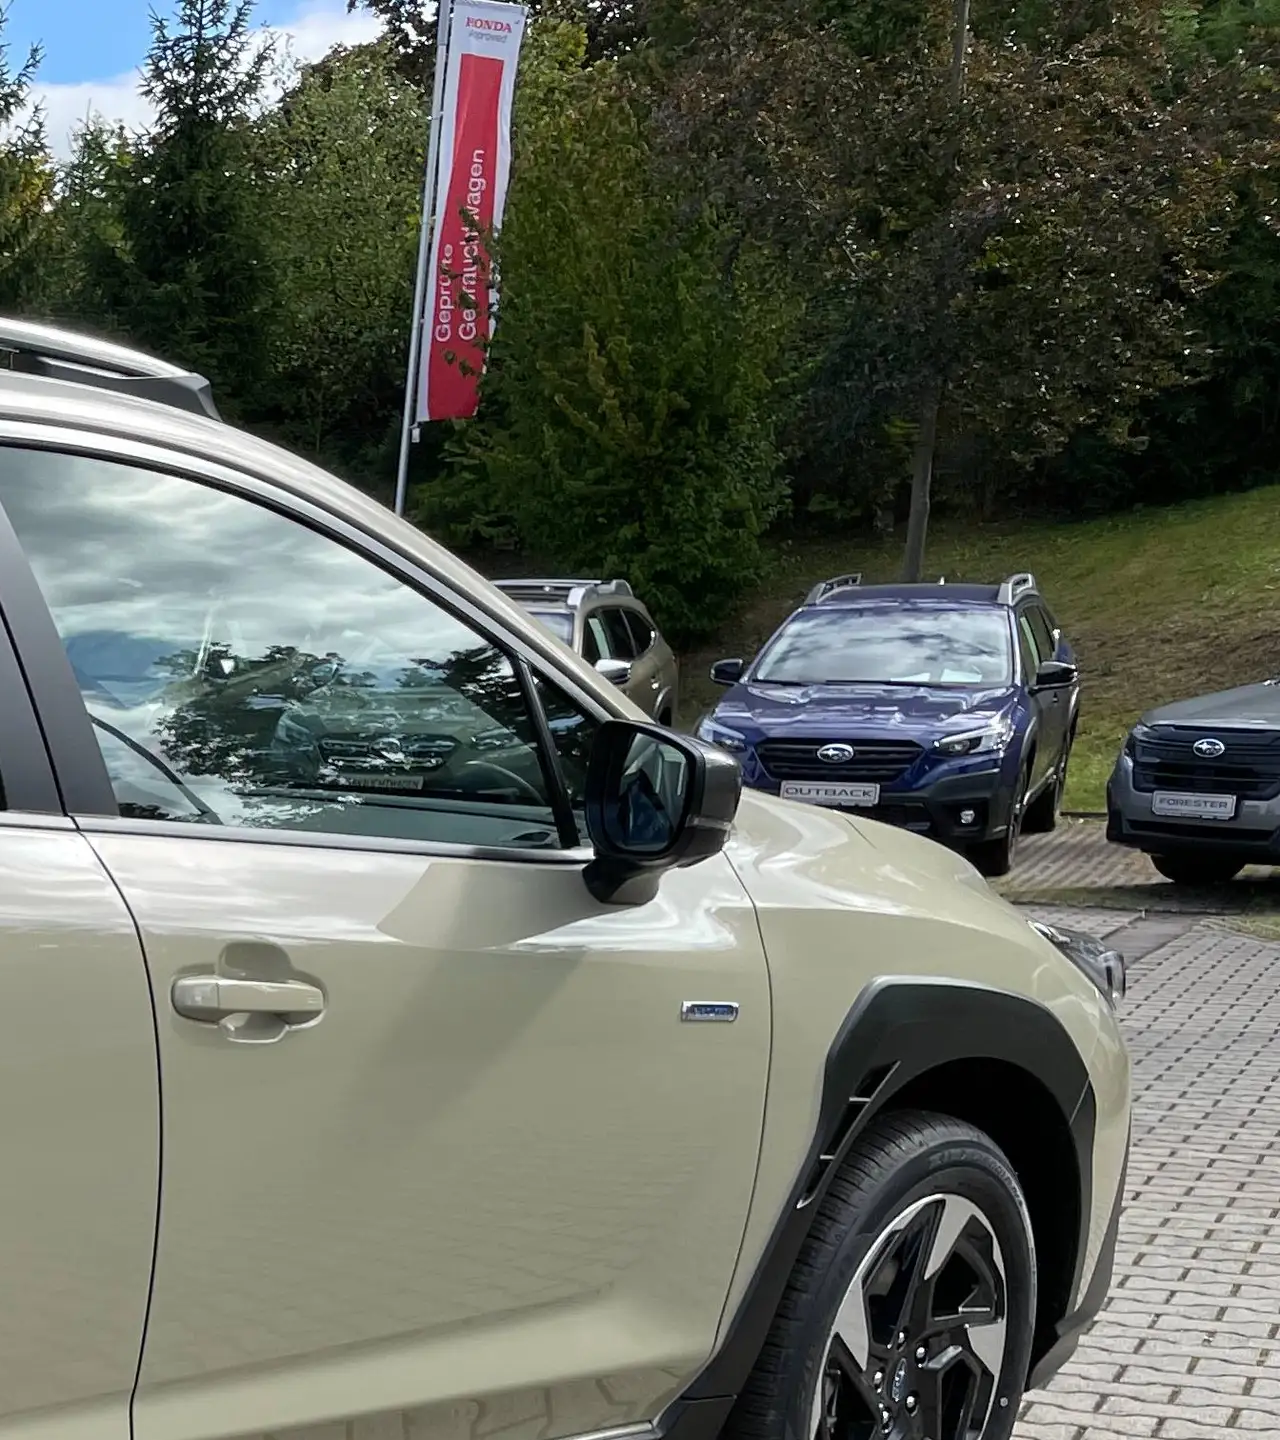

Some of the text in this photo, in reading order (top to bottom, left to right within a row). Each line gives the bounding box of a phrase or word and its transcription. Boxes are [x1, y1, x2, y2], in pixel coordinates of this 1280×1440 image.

[465, 16, 512, 33] HONDA
[785, 786, 873, 798] OUTBACK
[1158, 796, 1228, 809] FORESTER
